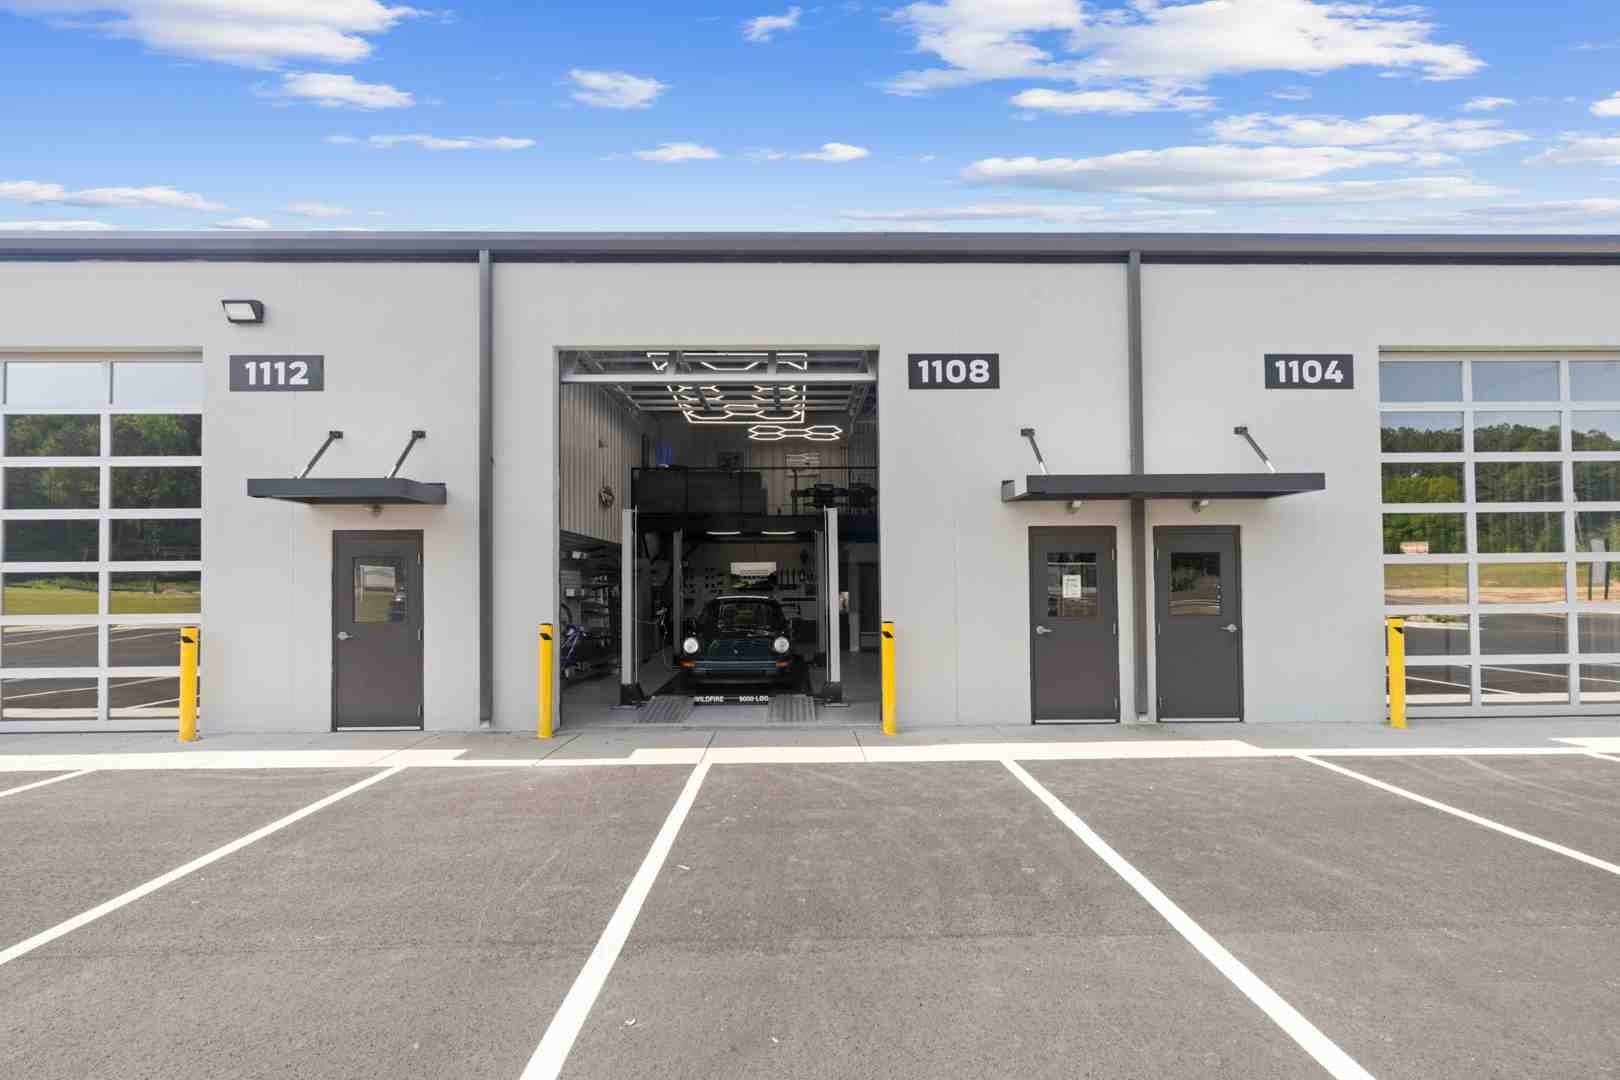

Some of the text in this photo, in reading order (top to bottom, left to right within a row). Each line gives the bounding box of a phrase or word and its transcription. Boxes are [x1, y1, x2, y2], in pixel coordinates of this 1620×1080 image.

[245, 360, 309, 386] 1112
[918, 360, 990, 384] 1108
[1276, 360, 1344, 384] 1104
